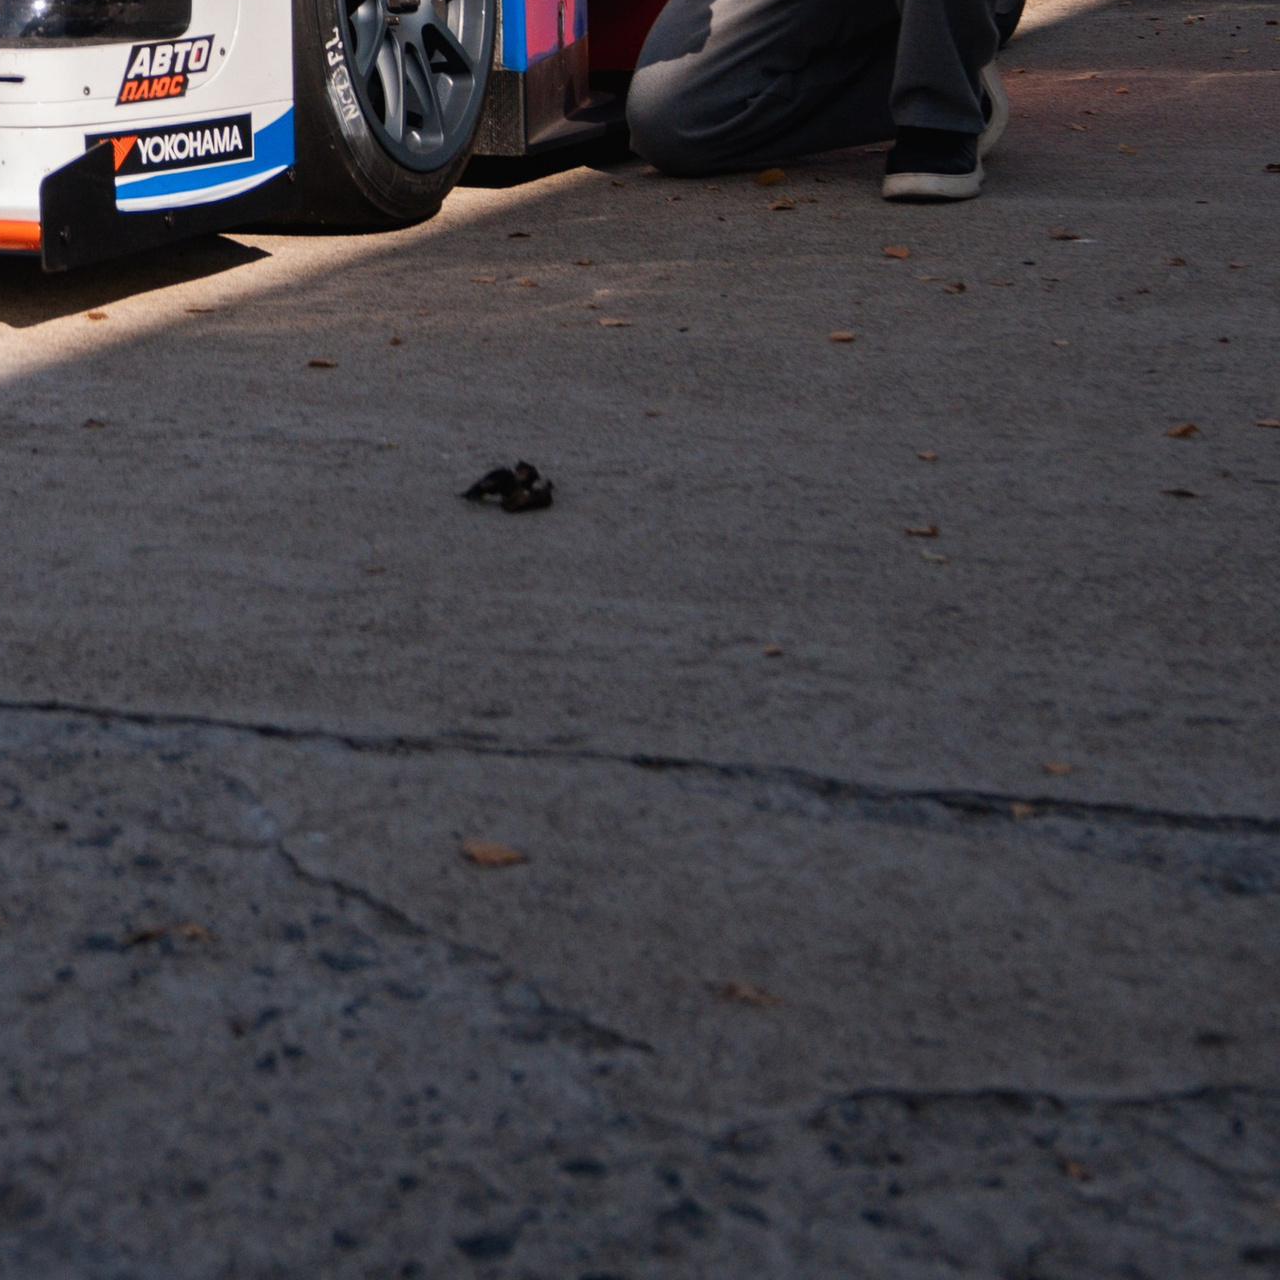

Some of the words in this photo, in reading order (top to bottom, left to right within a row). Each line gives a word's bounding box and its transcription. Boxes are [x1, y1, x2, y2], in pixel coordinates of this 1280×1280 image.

[127, 39, 210, 79] АВТО
[120, 74, 185, 103] ПЛЮС
[137, 124, 243, 165] YOKOHAMA
